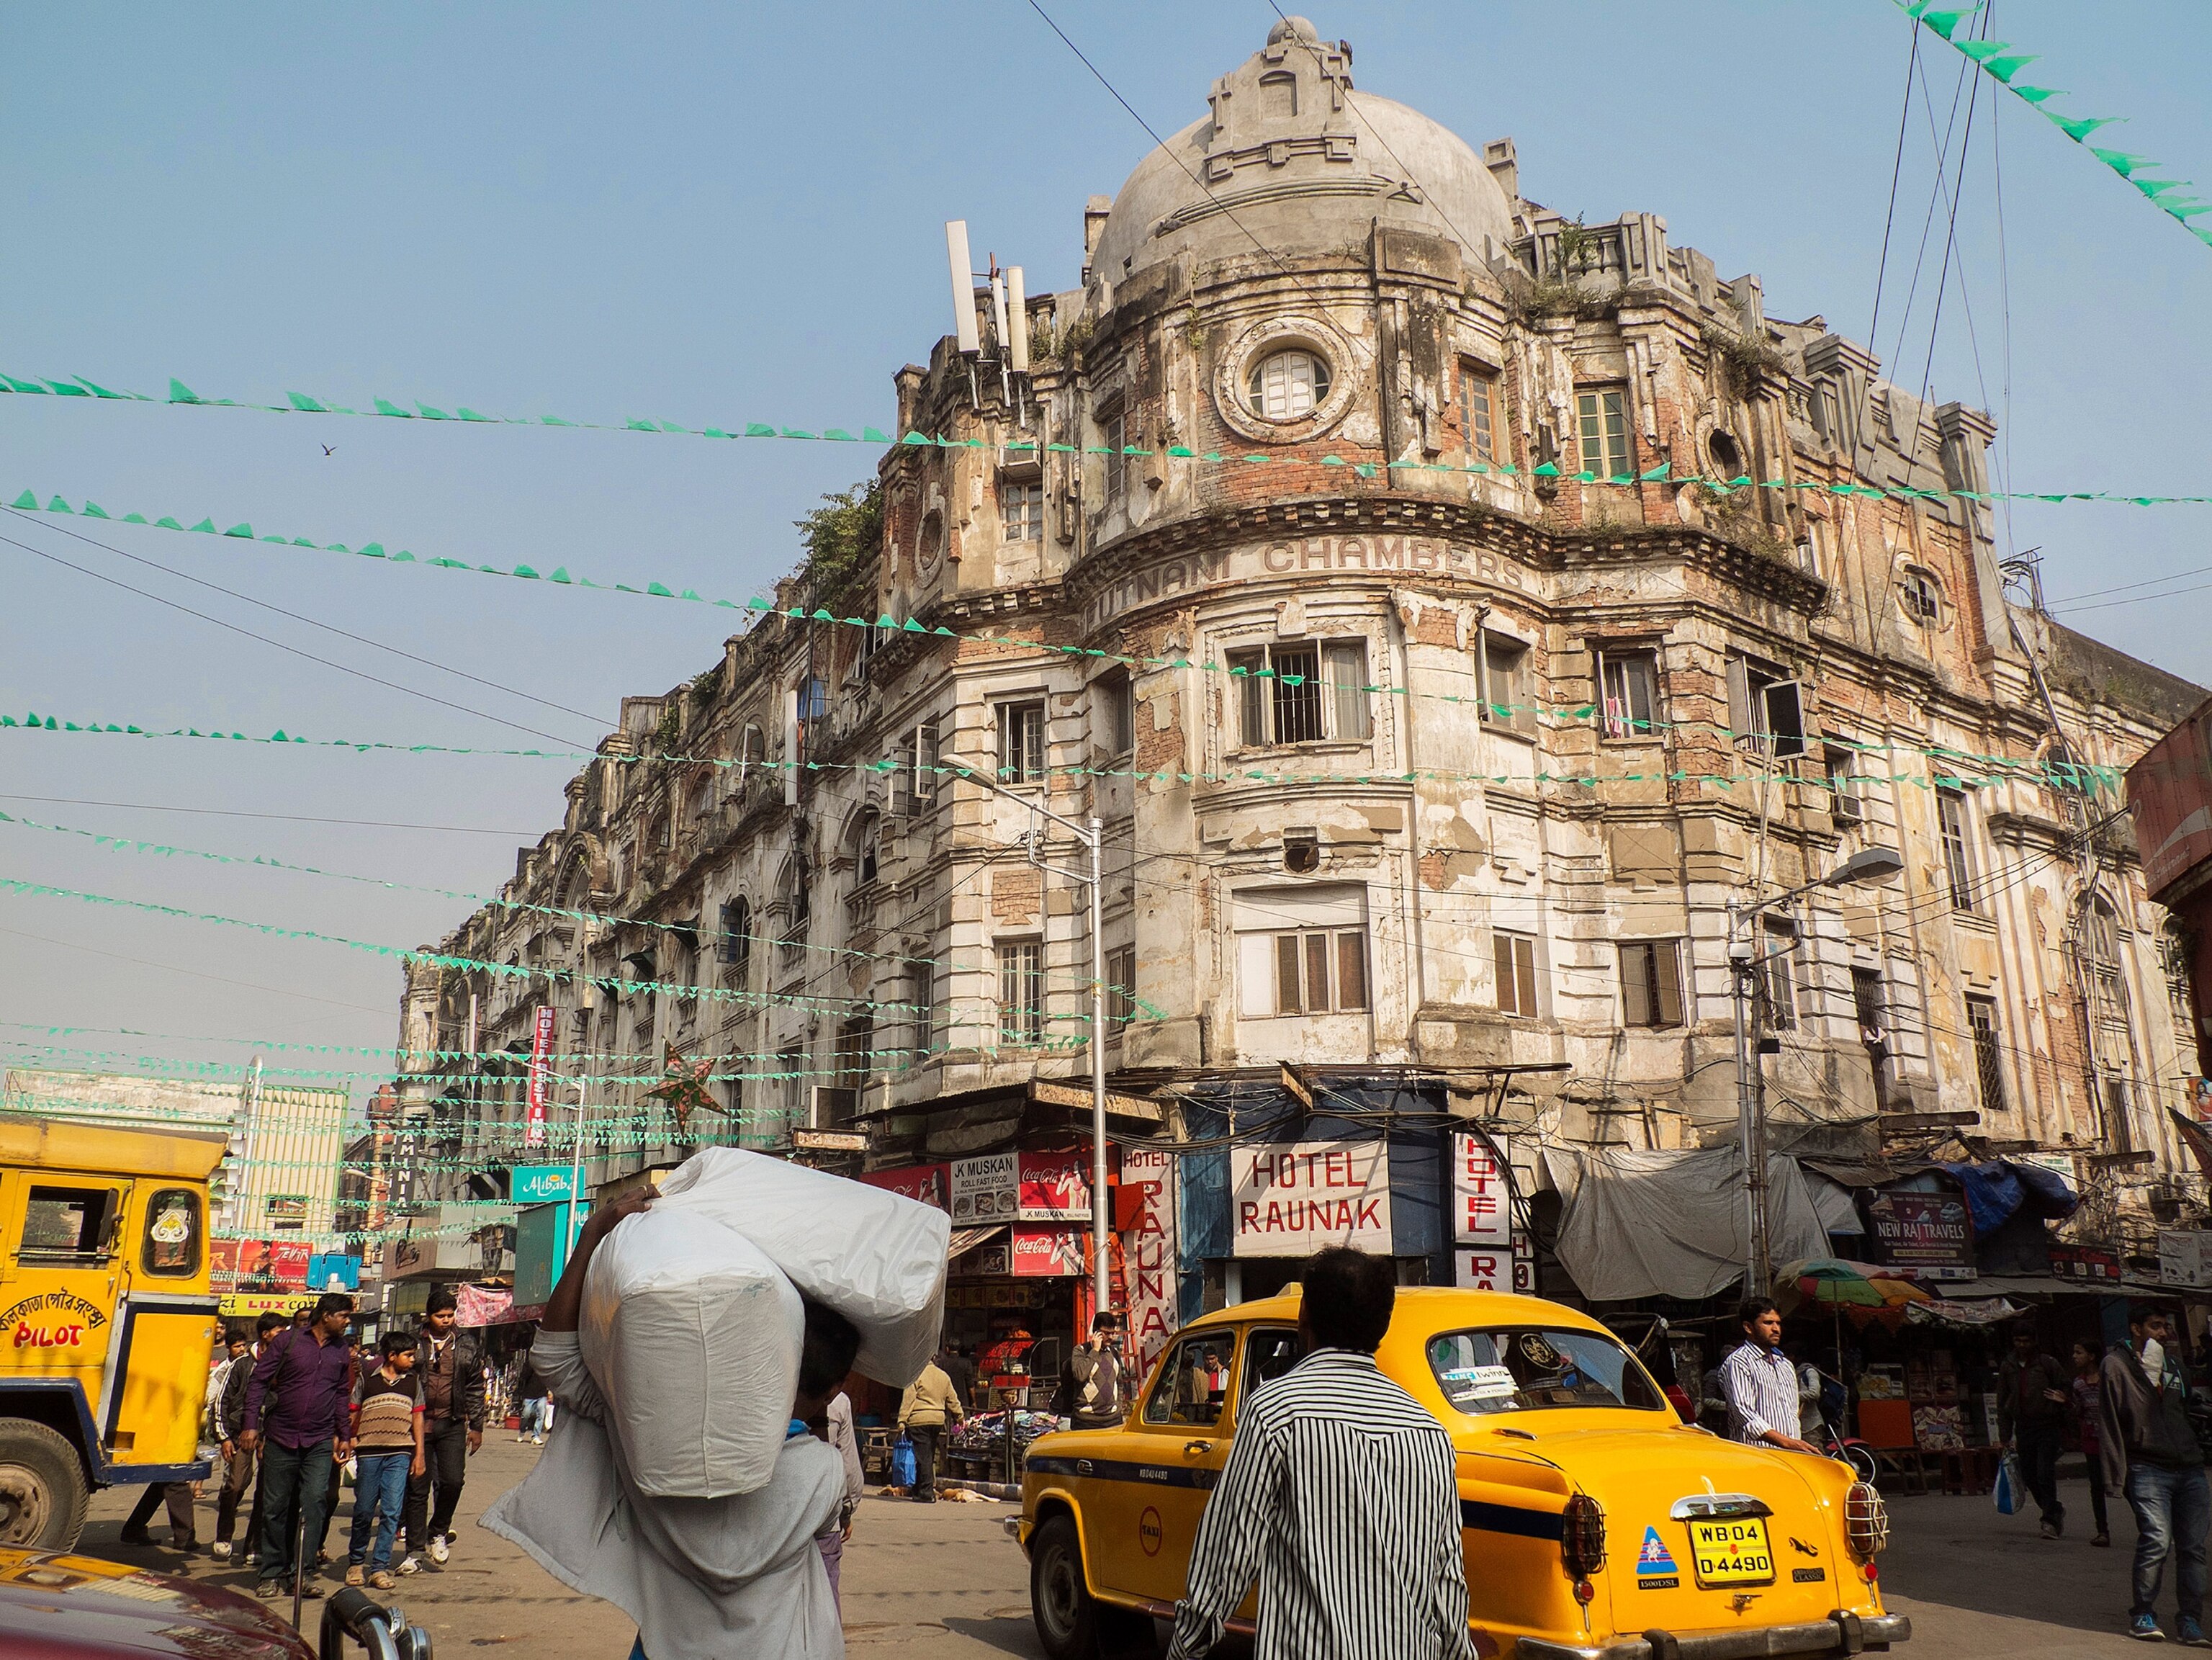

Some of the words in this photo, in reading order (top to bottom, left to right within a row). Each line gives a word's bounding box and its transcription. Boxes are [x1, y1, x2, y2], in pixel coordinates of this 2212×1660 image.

[1264, 537, 1523, 589] CHAMBERS
[539, 1009, 553, 1058] HOTEL
[954, 1164, 965, 1177] JK
[968, 1157, 1012, 1177] MUSKAN
[1123, 1152, 1169, 1167] HOTEL
[1022, 1167, 1058, 1183] Coca-Cola
[1253, 1152, 1367, 1188] HOTEL
[961, 1179, 976, 1188] ROLL
[976, 1177, 990, 1185] FAST
[992, 1175, 1007, 1184] FOOD
[1467, 1139, 1497, 1233] HOTEL
[1240, 1198, 1382, 1234] RAUNAK
[1876, 1222, 1901, 1237] NEW
[1903, 1223, 1921, 1240] RAJ
[1923, 1224, 1964, 1239] TRAVELS
[1015, 1237, 1053, 1254] Coca-Cola
[1137, 1179, 1169, 1378] RAUNAK
[248, 1300, 285, 1310] LUX
[14, 1322, 84, 1348] PILOT
[1142, 1524, 1159, 1538] TAXI
[1640, 1579, 1678, 1588] 1500DSL
